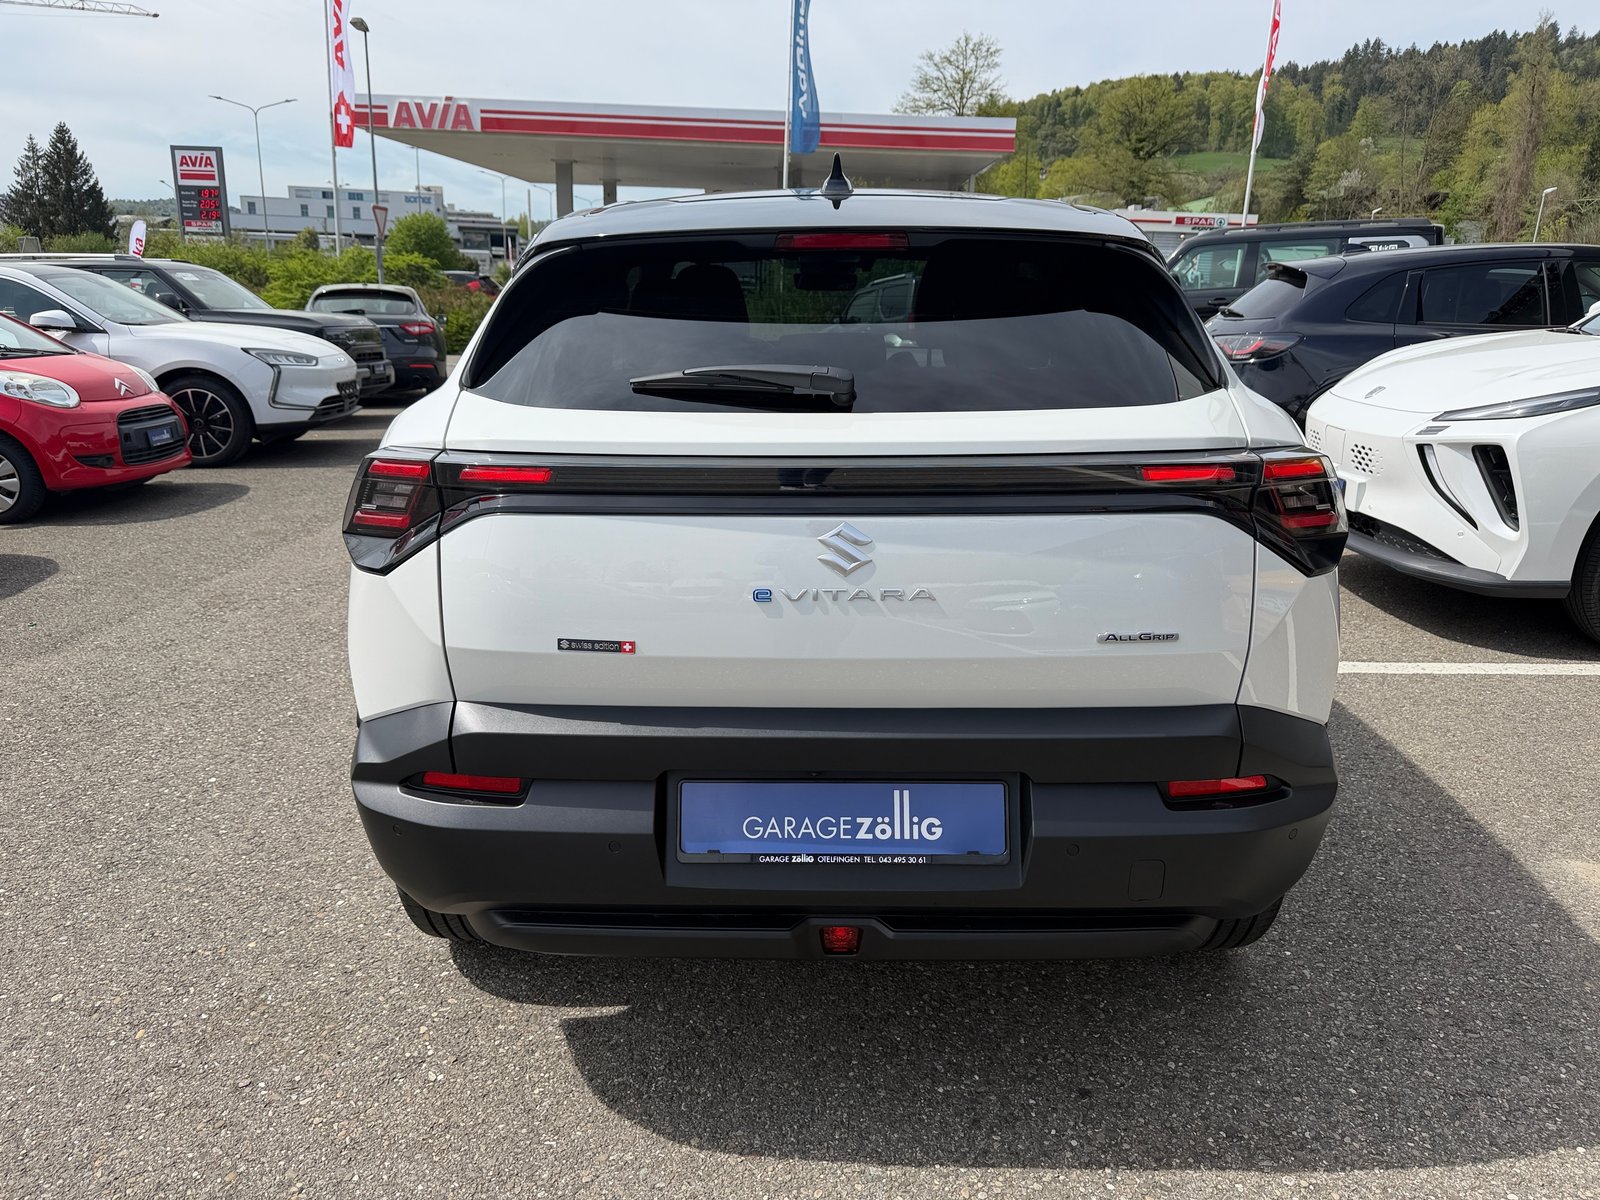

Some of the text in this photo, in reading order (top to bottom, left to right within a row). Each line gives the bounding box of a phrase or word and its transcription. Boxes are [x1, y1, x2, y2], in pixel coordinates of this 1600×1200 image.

[393, 96, 474, 130] AVIA
[179, 153, 214, 168] AVIA
[1184, 217, 1214, 225] SPAR
[779, 588, 937, 602] VITARA
[1105, 633, 1175, 641] ALLGRIP
[570, 641, 620, 651] swiss edition
[742, 816, 852, 840] GARAGE
[758, 855, 790, 863] GARAGE
[817, 855, 861, 863] OTELFINGEN
[893, 856, 907, 864] 495
[907, 856, 917, 864] 30
[918, 856, 926, 864] 61
